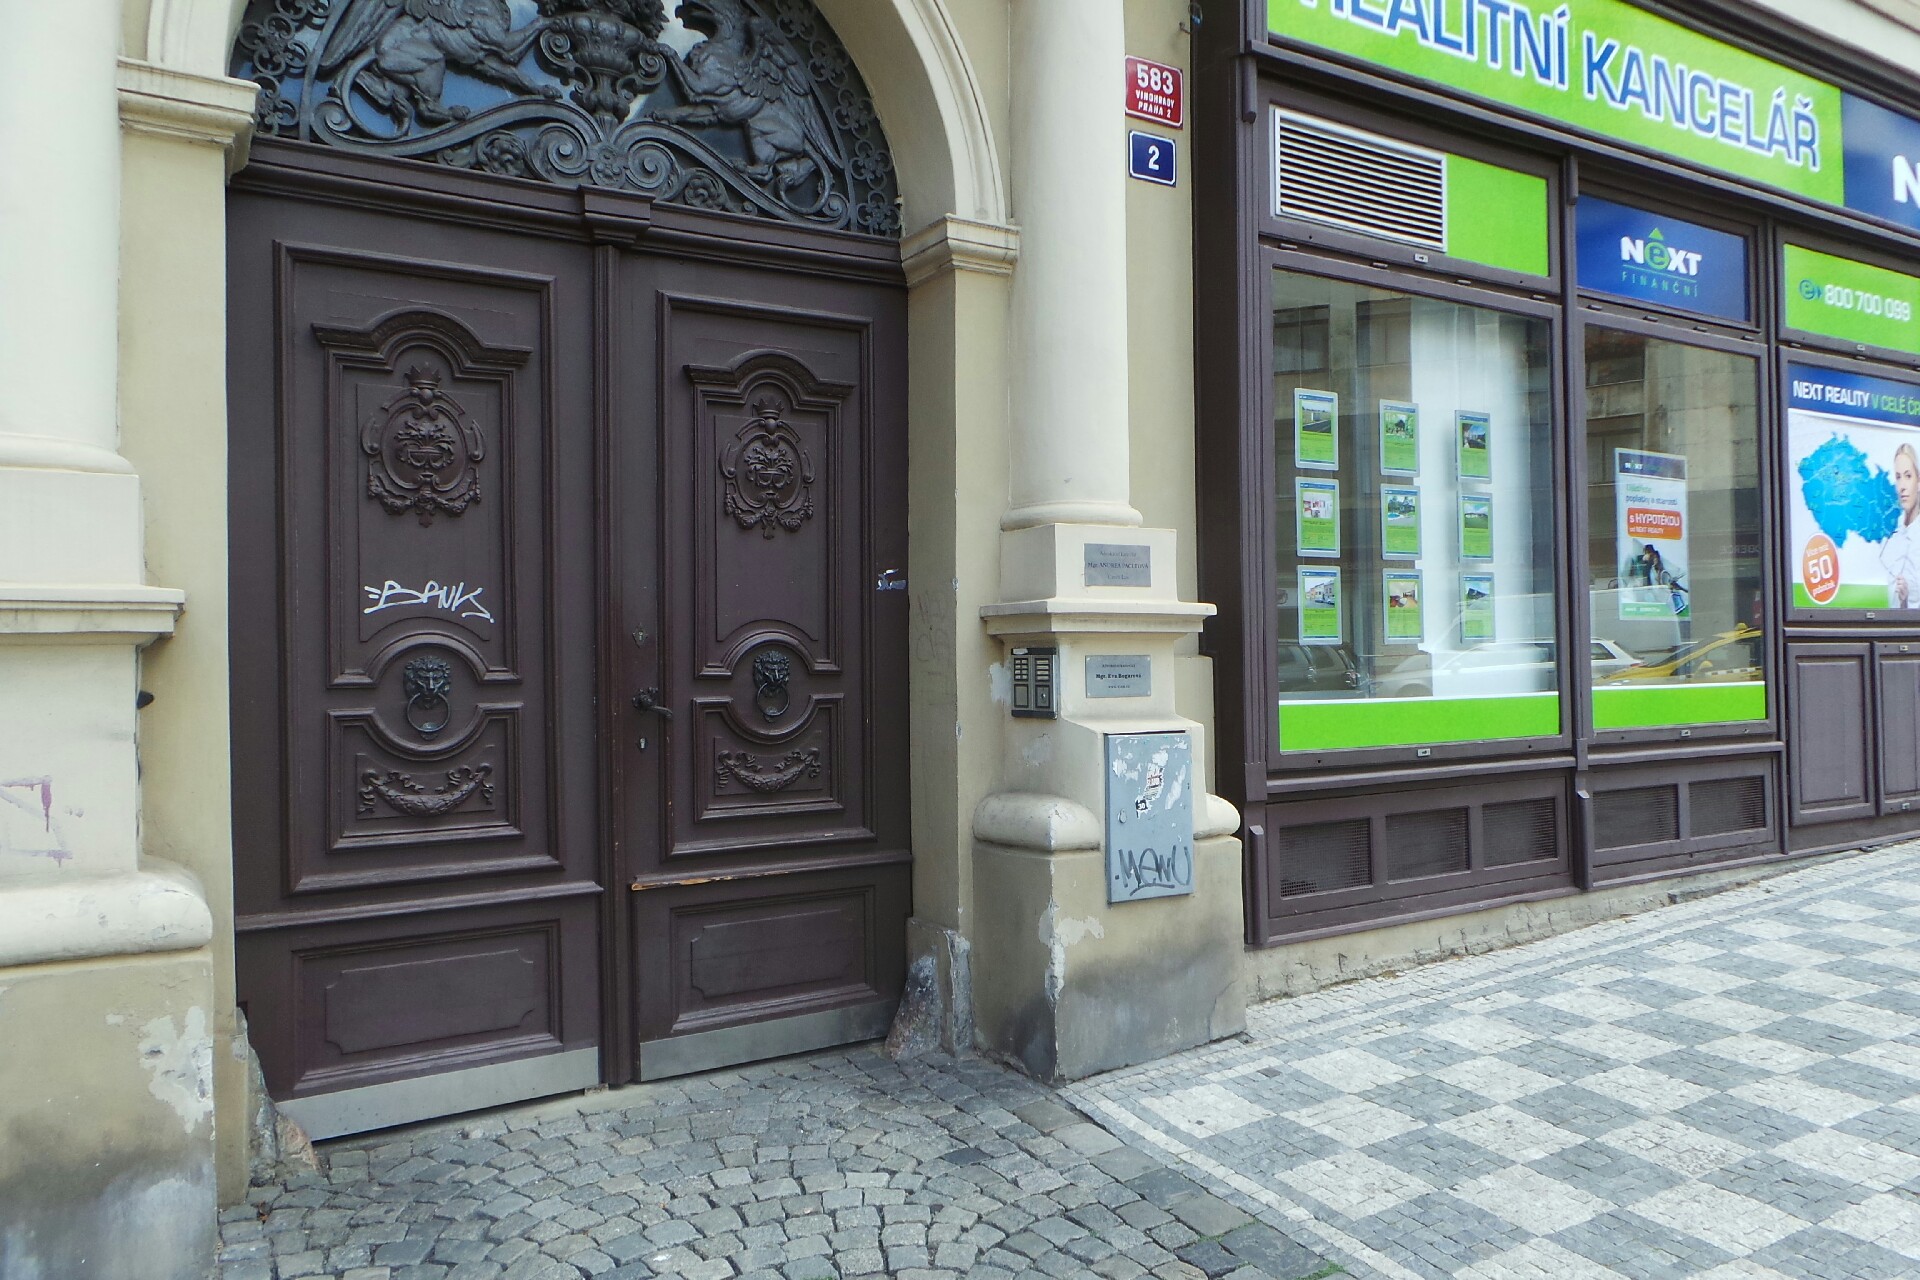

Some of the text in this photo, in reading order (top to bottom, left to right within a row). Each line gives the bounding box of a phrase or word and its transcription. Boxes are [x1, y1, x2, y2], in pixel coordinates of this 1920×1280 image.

[1137, 63, 1173, 95] 583
[1135, 89, 1175, 108] VINOHRADY
[1138, 101, 1172, 118] PRAHA 2
[1584, 32, 1820, 171] KANCELÁŘ
[1148, 145, 1160, 170] 2
[1622, 271, 1698, 298] FINANČNÍ
[1824, 284, 1853, 309] 800
[1855, 290, 1883, 316] 700
[1884, 297, 1911, 322] 099
[1792, 380, 1823, 401] NEXT
[1824, 385, 1870, 408] REALITY
[1871, 393, 1881, 409] V
[1881, 395, 1906, 413] CELÉ
[1629, 513, 1680, 526] s HYPOTÉKOU
[1808, 555, 1833, 584] 50
